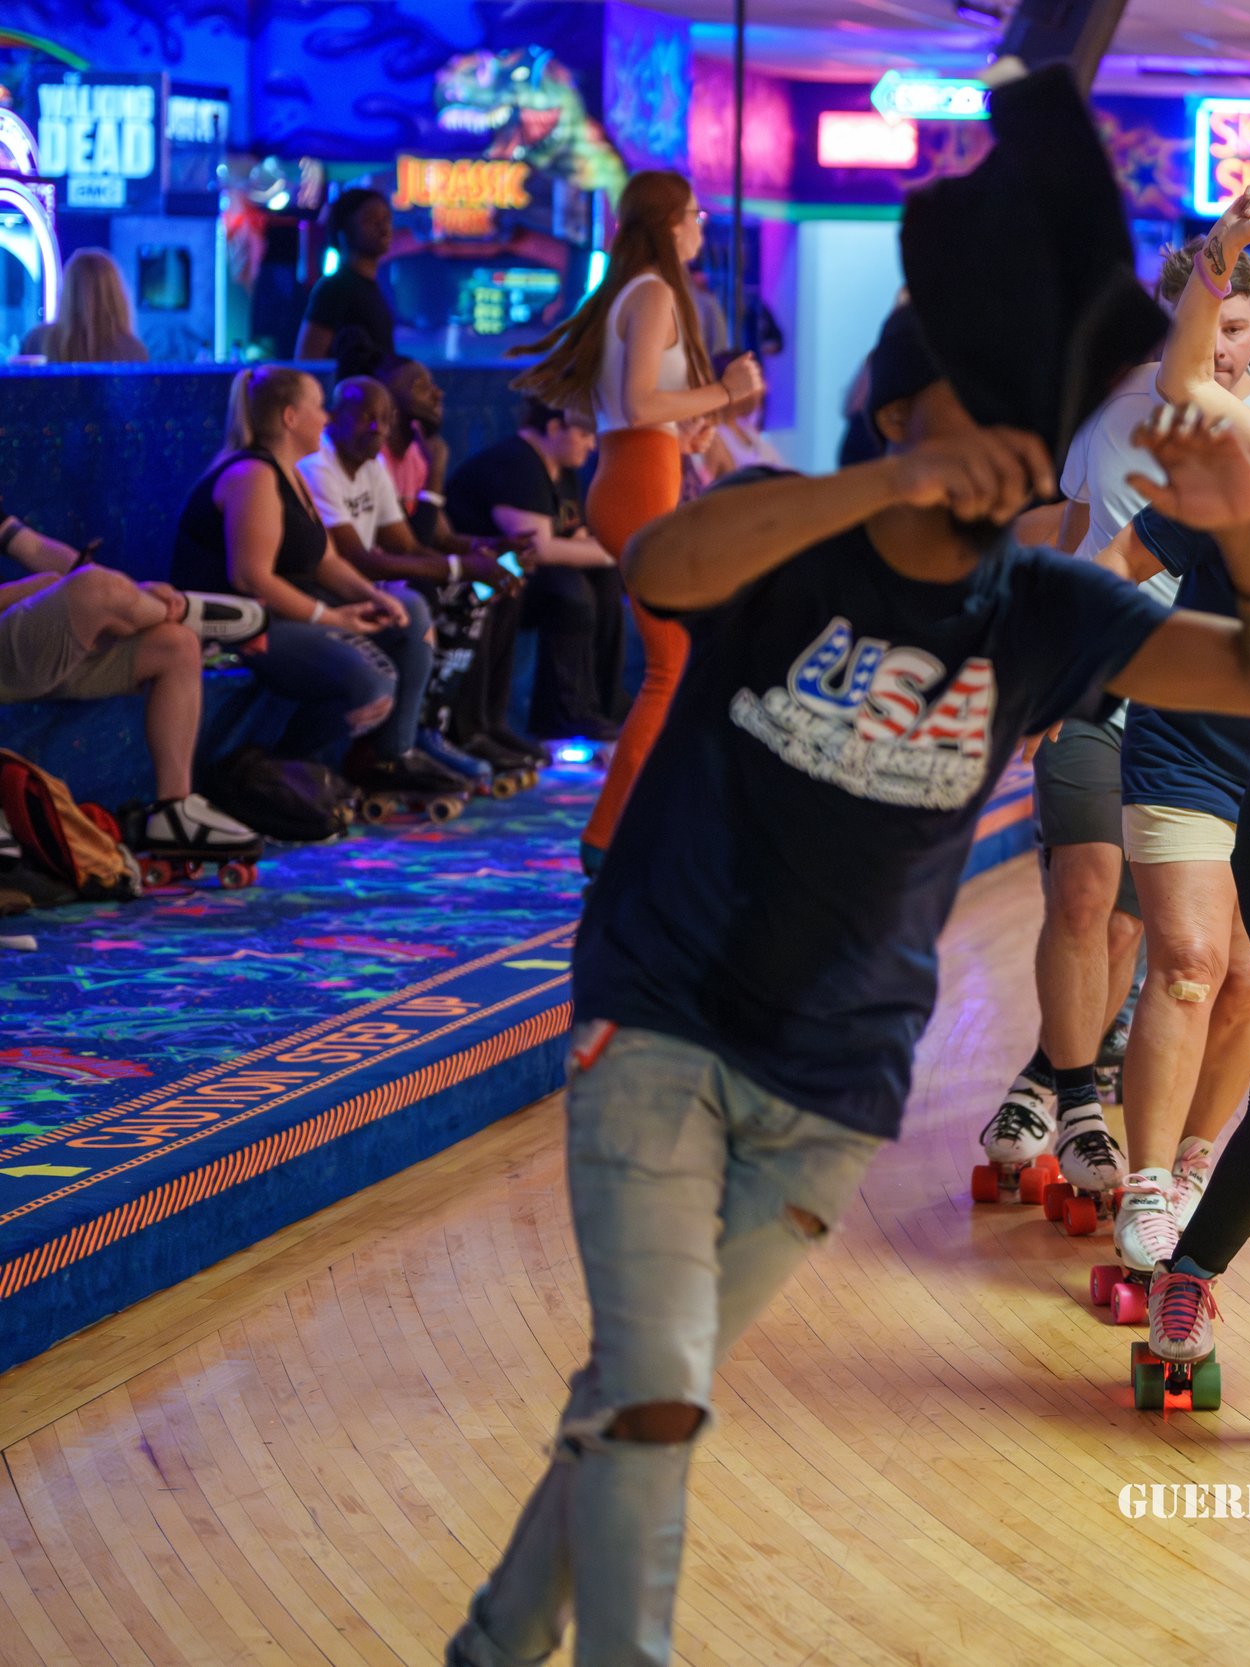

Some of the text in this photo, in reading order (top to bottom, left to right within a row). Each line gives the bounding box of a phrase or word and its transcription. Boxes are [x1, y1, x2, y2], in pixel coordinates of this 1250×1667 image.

[38, 118, 155, 179] DEAD
[787, 615, 998, 760] USA
[66, 995, 482, 1151] CAUTION STEP UP
